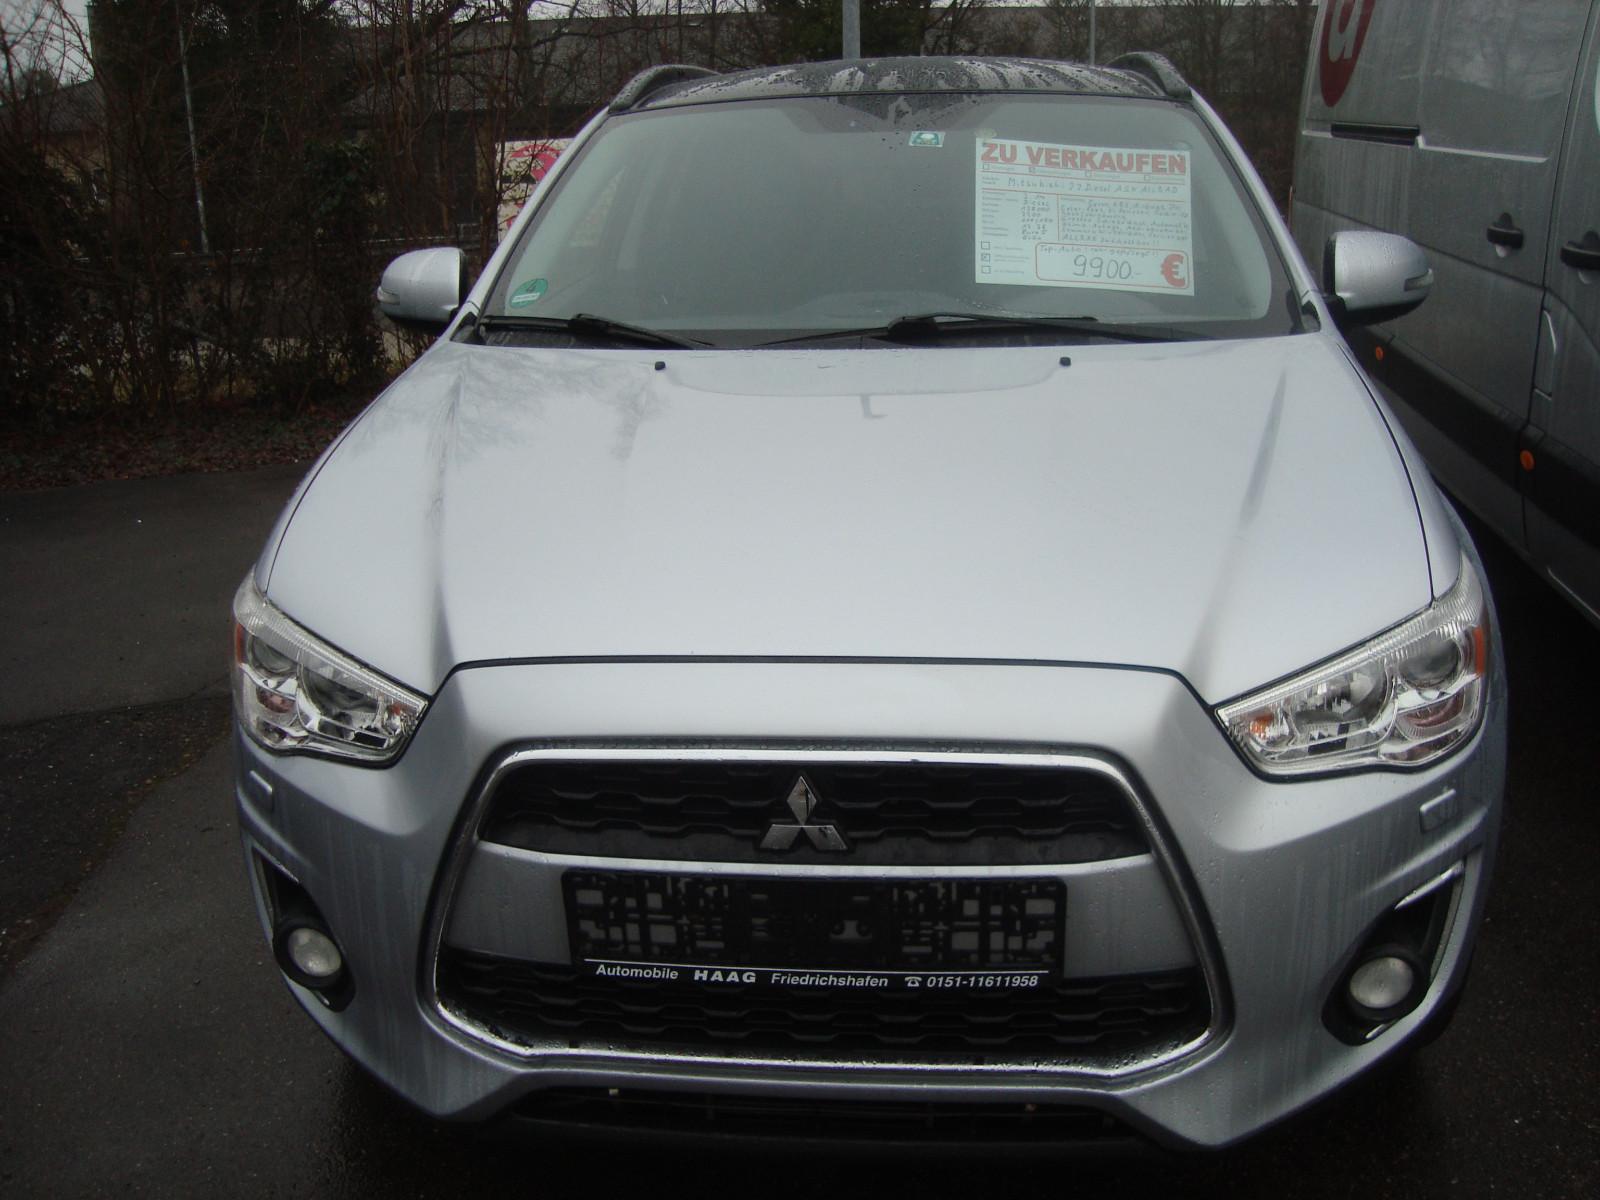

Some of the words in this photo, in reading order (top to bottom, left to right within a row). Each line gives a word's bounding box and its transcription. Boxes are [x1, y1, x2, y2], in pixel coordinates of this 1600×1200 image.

[981, 143, 1018, 163] ZU
[1027, 147, 1186, 174] VERKAUFEN
[1160, 253, 1186, 288] €
[595, 964, 679, 981] Automobile
[693, 969, 757, 984] HAAG
[771, 972, 889, 988] Friedrichshafen
[926, 974, 1039, 989] 0151-11611958
